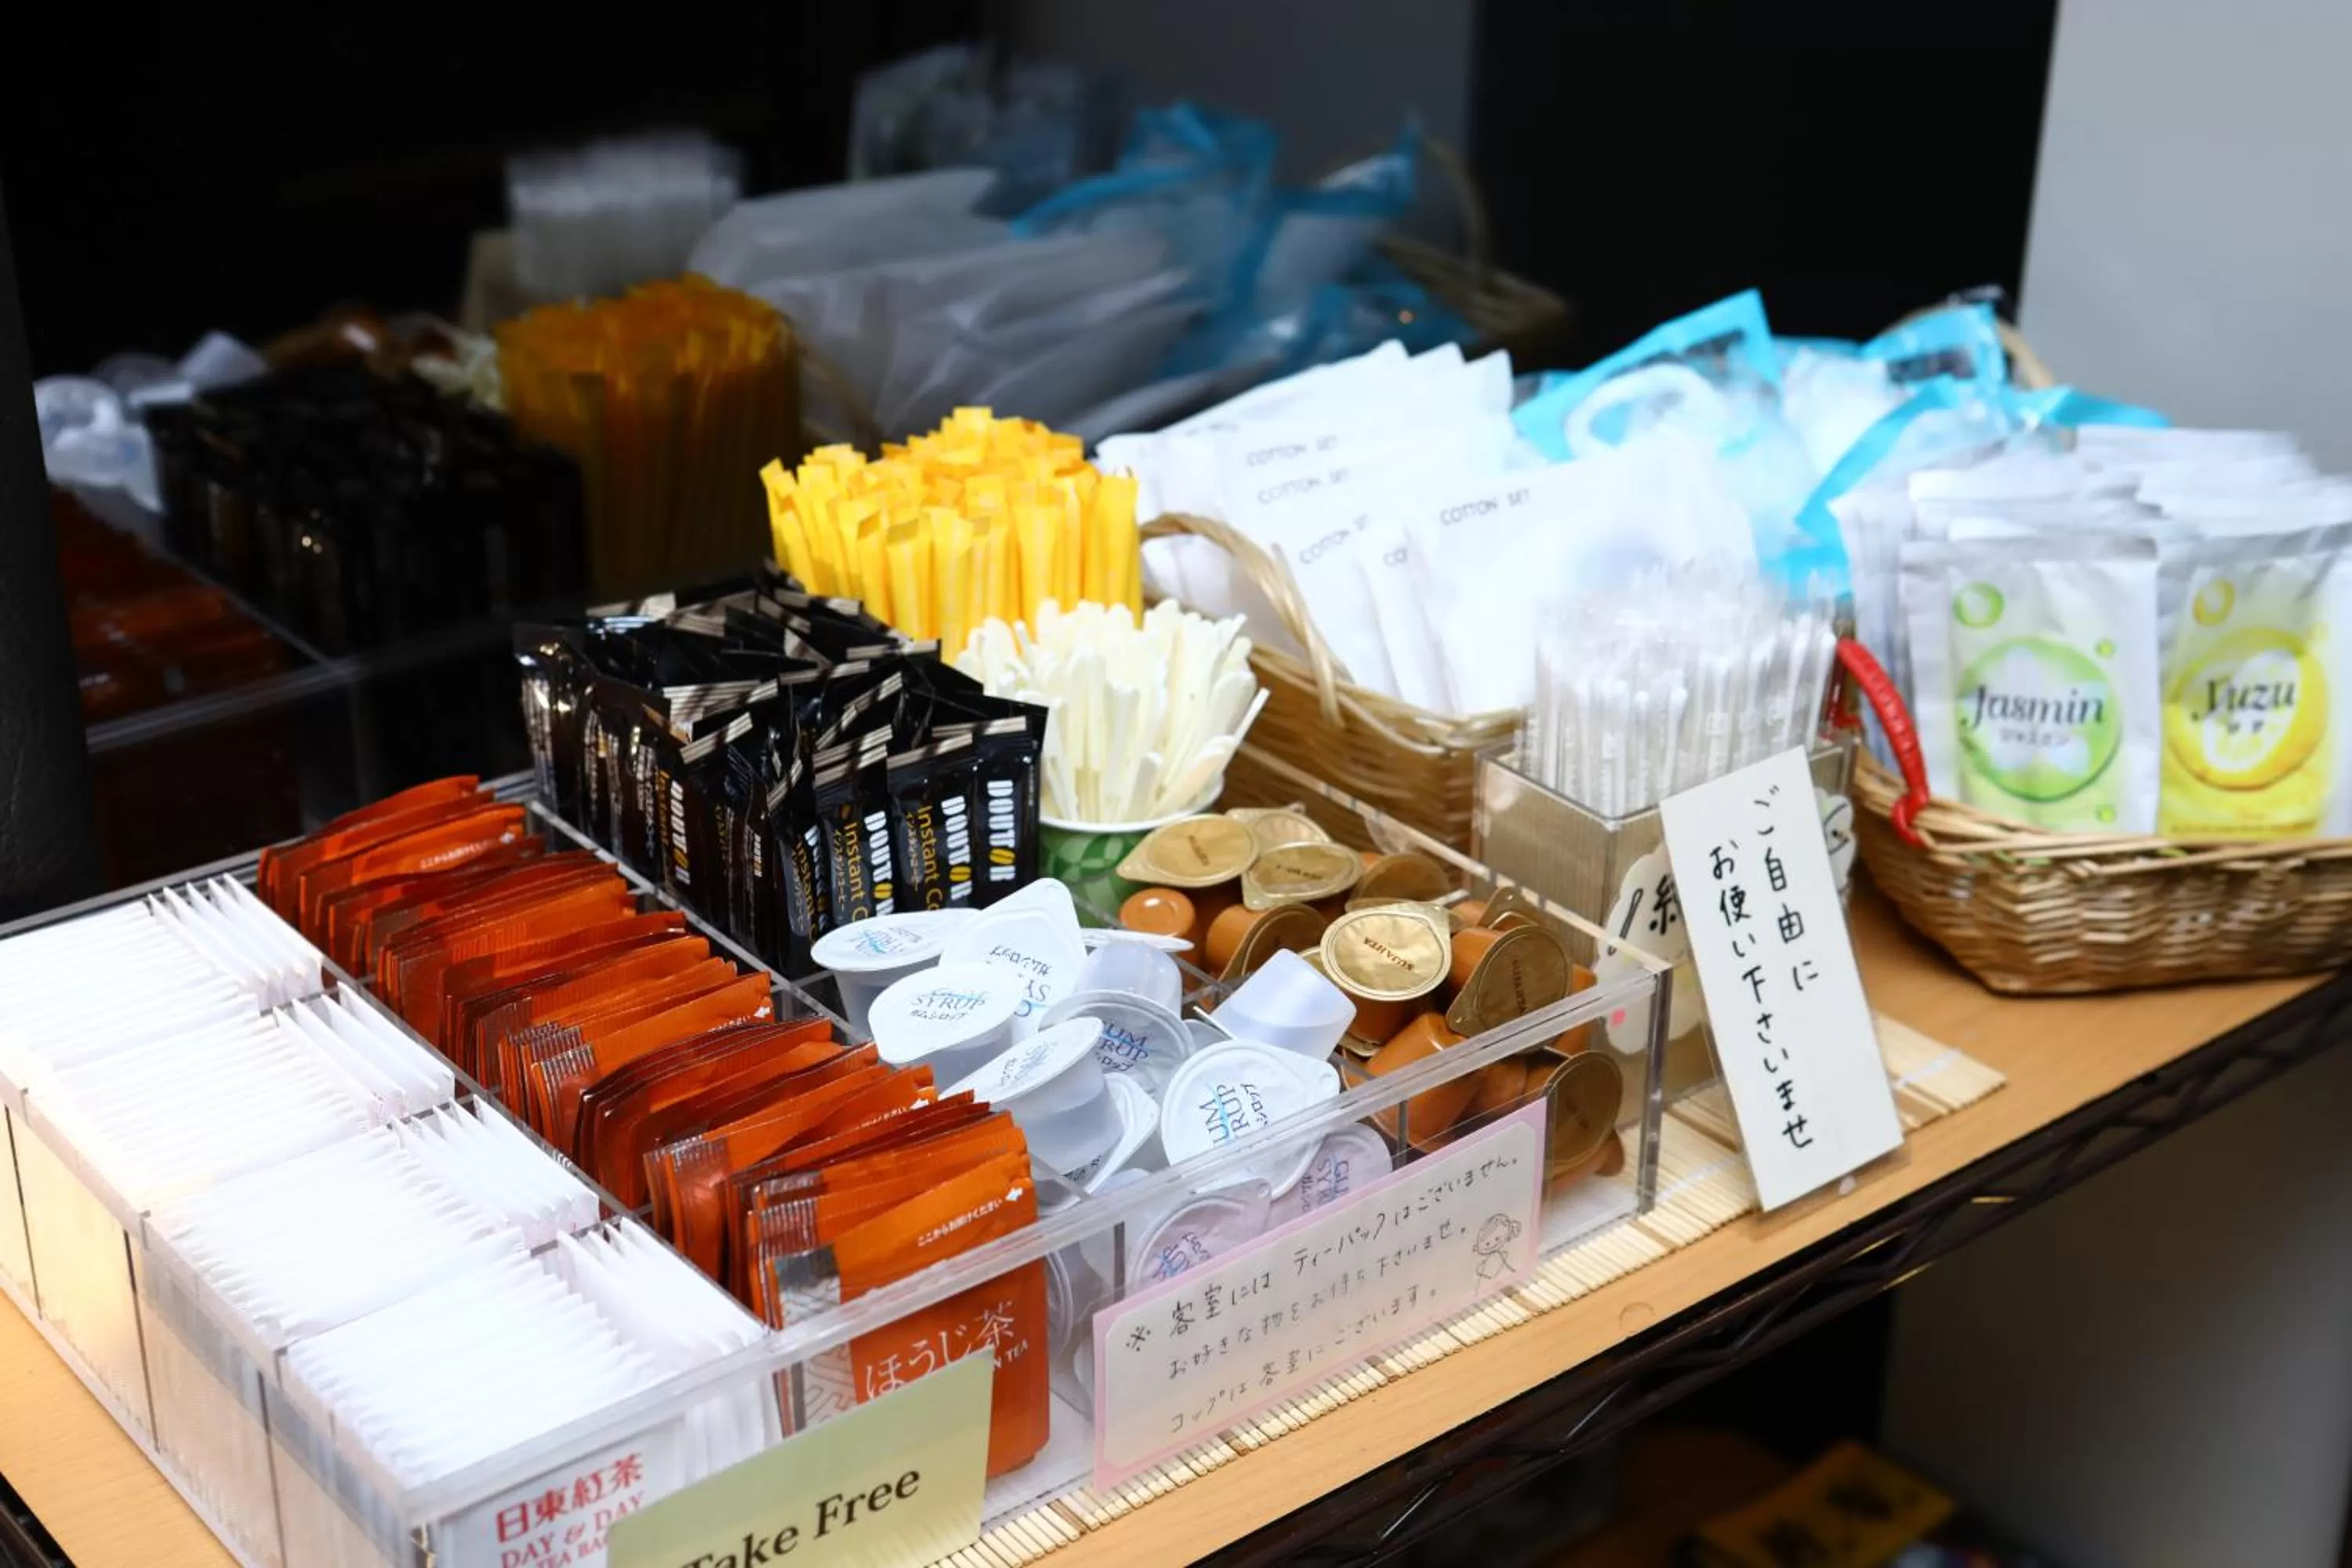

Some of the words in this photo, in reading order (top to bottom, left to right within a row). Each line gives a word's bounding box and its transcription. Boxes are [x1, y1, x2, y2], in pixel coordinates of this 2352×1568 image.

[1247, 442, 1307, 466] COTTON
[1257, 477, 1322, 505] COTTON
[1439, 497, 1499, 527] COTTON
[1506, 487, 1530, 508] SET
[1960, 683, 2104, 731] Jasmin
[2190, 677, 2296, 723] Yuzu
[670, 779, 691, 886] DOUTOR
[916, 805, 941, 883] Instant
[941, 795, 973, 901] DOUTOR
[986, 779, 1016, 882] DOUTOR
[844, 822, 866, 901] Instant
[863, 810, 895, 916] DOUTOR
[1754, 786, 1820, 992] ご自由に
[1363, 934, 1416, 971] SUJAHTA
[911, 993, 986, 1011] SYRUP
[1708, 839, 1813, 1149] お使い下さいませ
[1100, 1038, 1149, 1062] RUP
[1102, 1020, 1149, 1048] UM
[1199, 1098, 1229, 1145] UM
[1216, 1083, 1250, 1133] RUP
[1240, 1082, 1269, 1126] シロップ
[1316, 1158, 1332, 1206] SYR
[1334, 1160, 1349, 1196] GU
[866, 1301, 1017, 1400] ほうじ茶
[495, 1451, 646, 1544] 日東紅茶
[593, 1490, 645, 1531] DAY
[812, 1469, 920, 1541] Free
